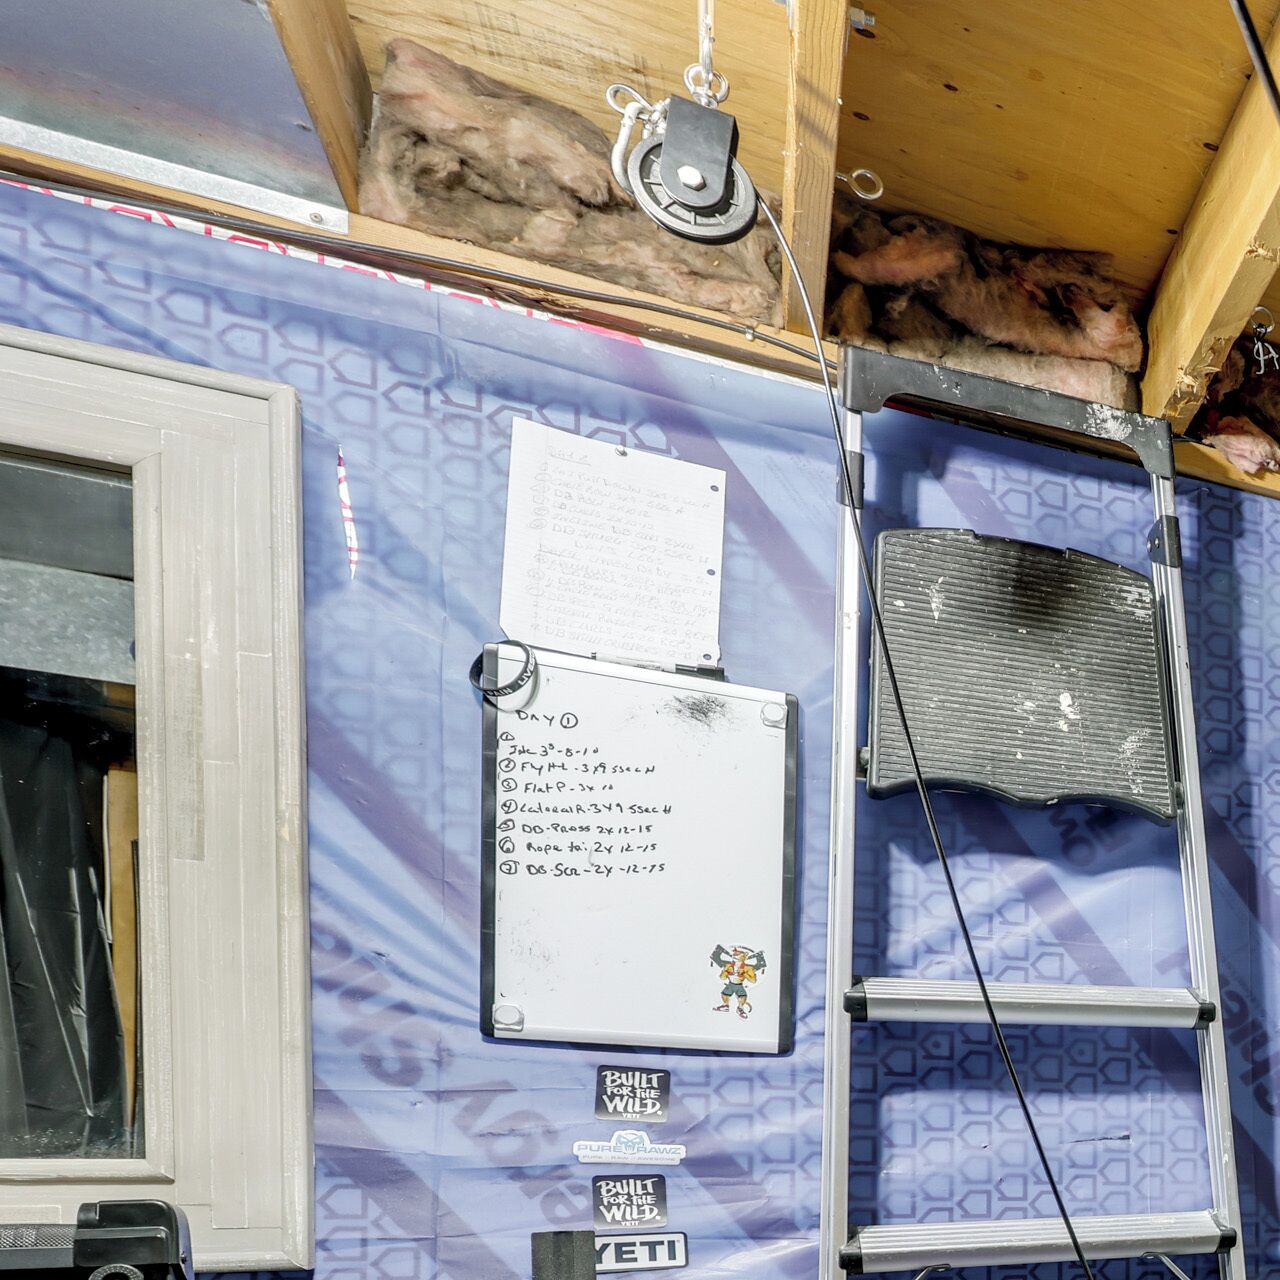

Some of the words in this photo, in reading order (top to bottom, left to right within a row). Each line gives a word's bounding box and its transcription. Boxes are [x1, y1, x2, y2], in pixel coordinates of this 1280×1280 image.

[601, 1071, 664, 1088] BUILT
[604, 1085, 634, 1096] FOR
[634, 1088, 661, 1098] THE
[602, 1095, 663, 1115] WILD.
[577, 1145, 622, 1153] PURE
[637, 1146, 681, 1154] RAWZ
[596, 1178, 659, 1196] BUILT
[600, 1195, 631, 1206] FOR
[631, 1195, 657, 1205] THE
[599, 1204, 661, 1222] WILD.
[595, 1240, 676, 1264] YETI
